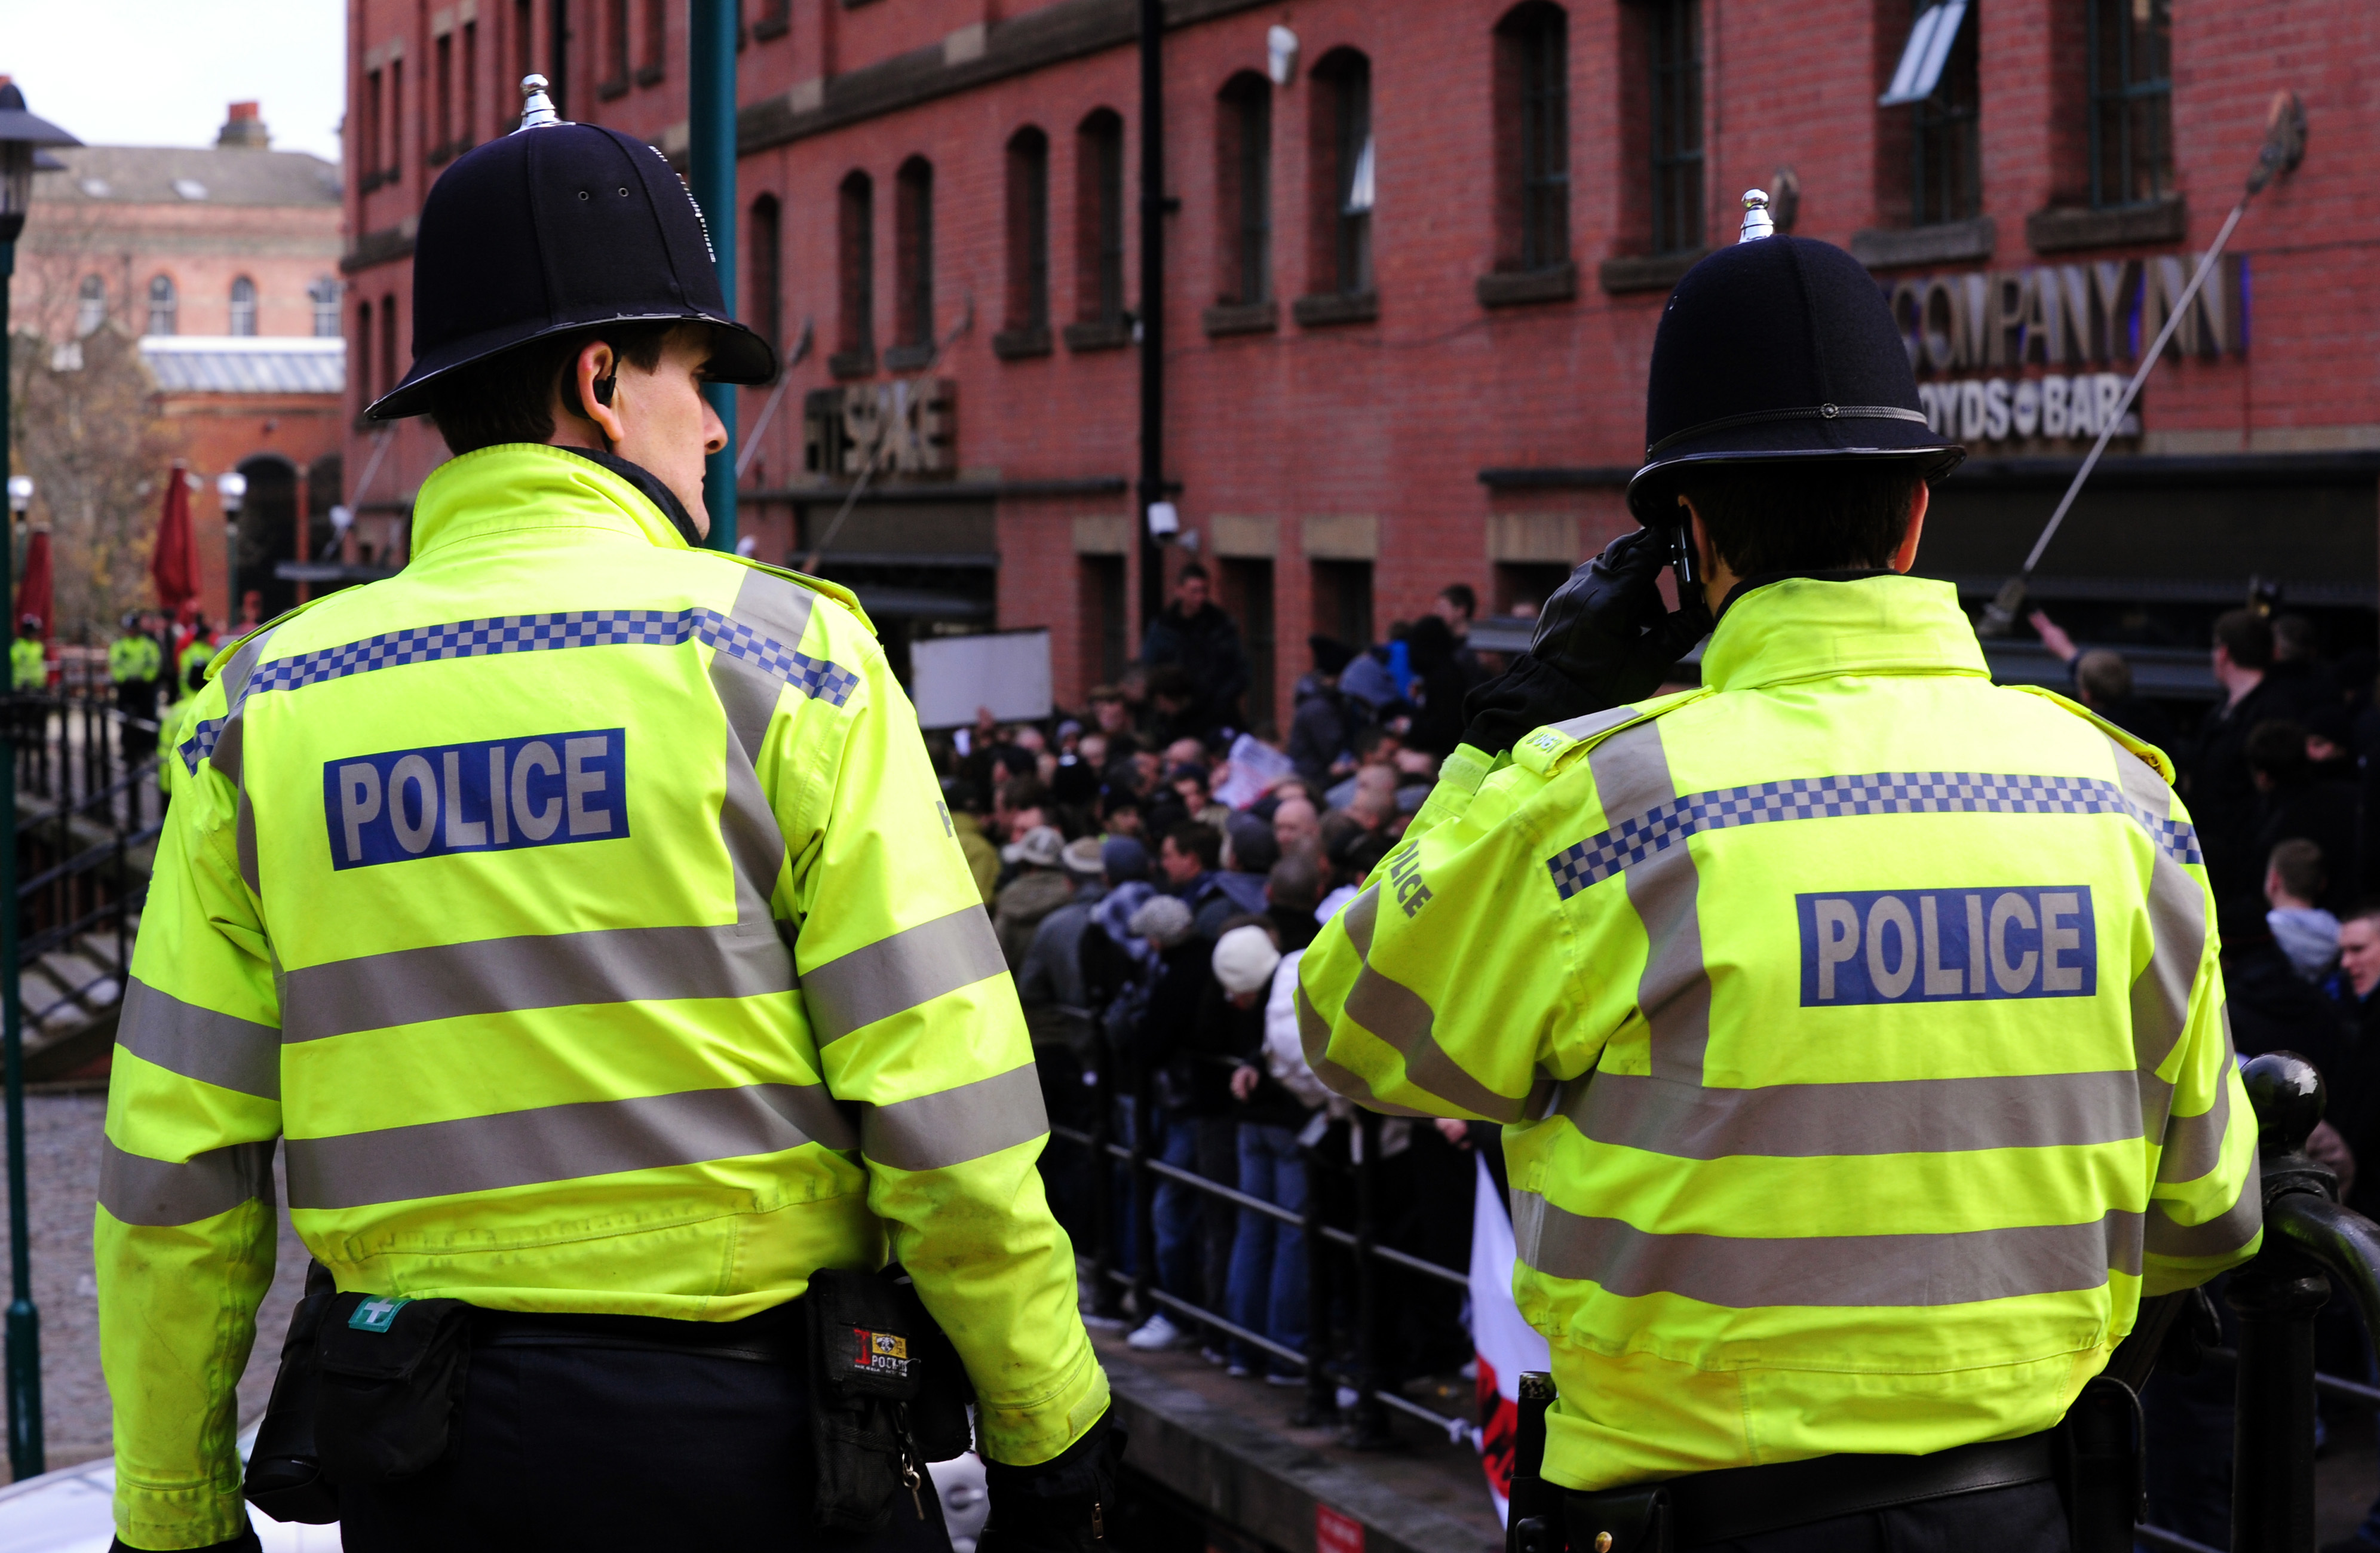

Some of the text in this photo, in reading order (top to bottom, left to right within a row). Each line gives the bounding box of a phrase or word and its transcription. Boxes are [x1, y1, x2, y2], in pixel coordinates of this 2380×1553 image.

[2041, 372, 2123, 438] BAR
[339, 735, 612, 862] POLICE
[1814, 891, 2082, 1000] POLICE
